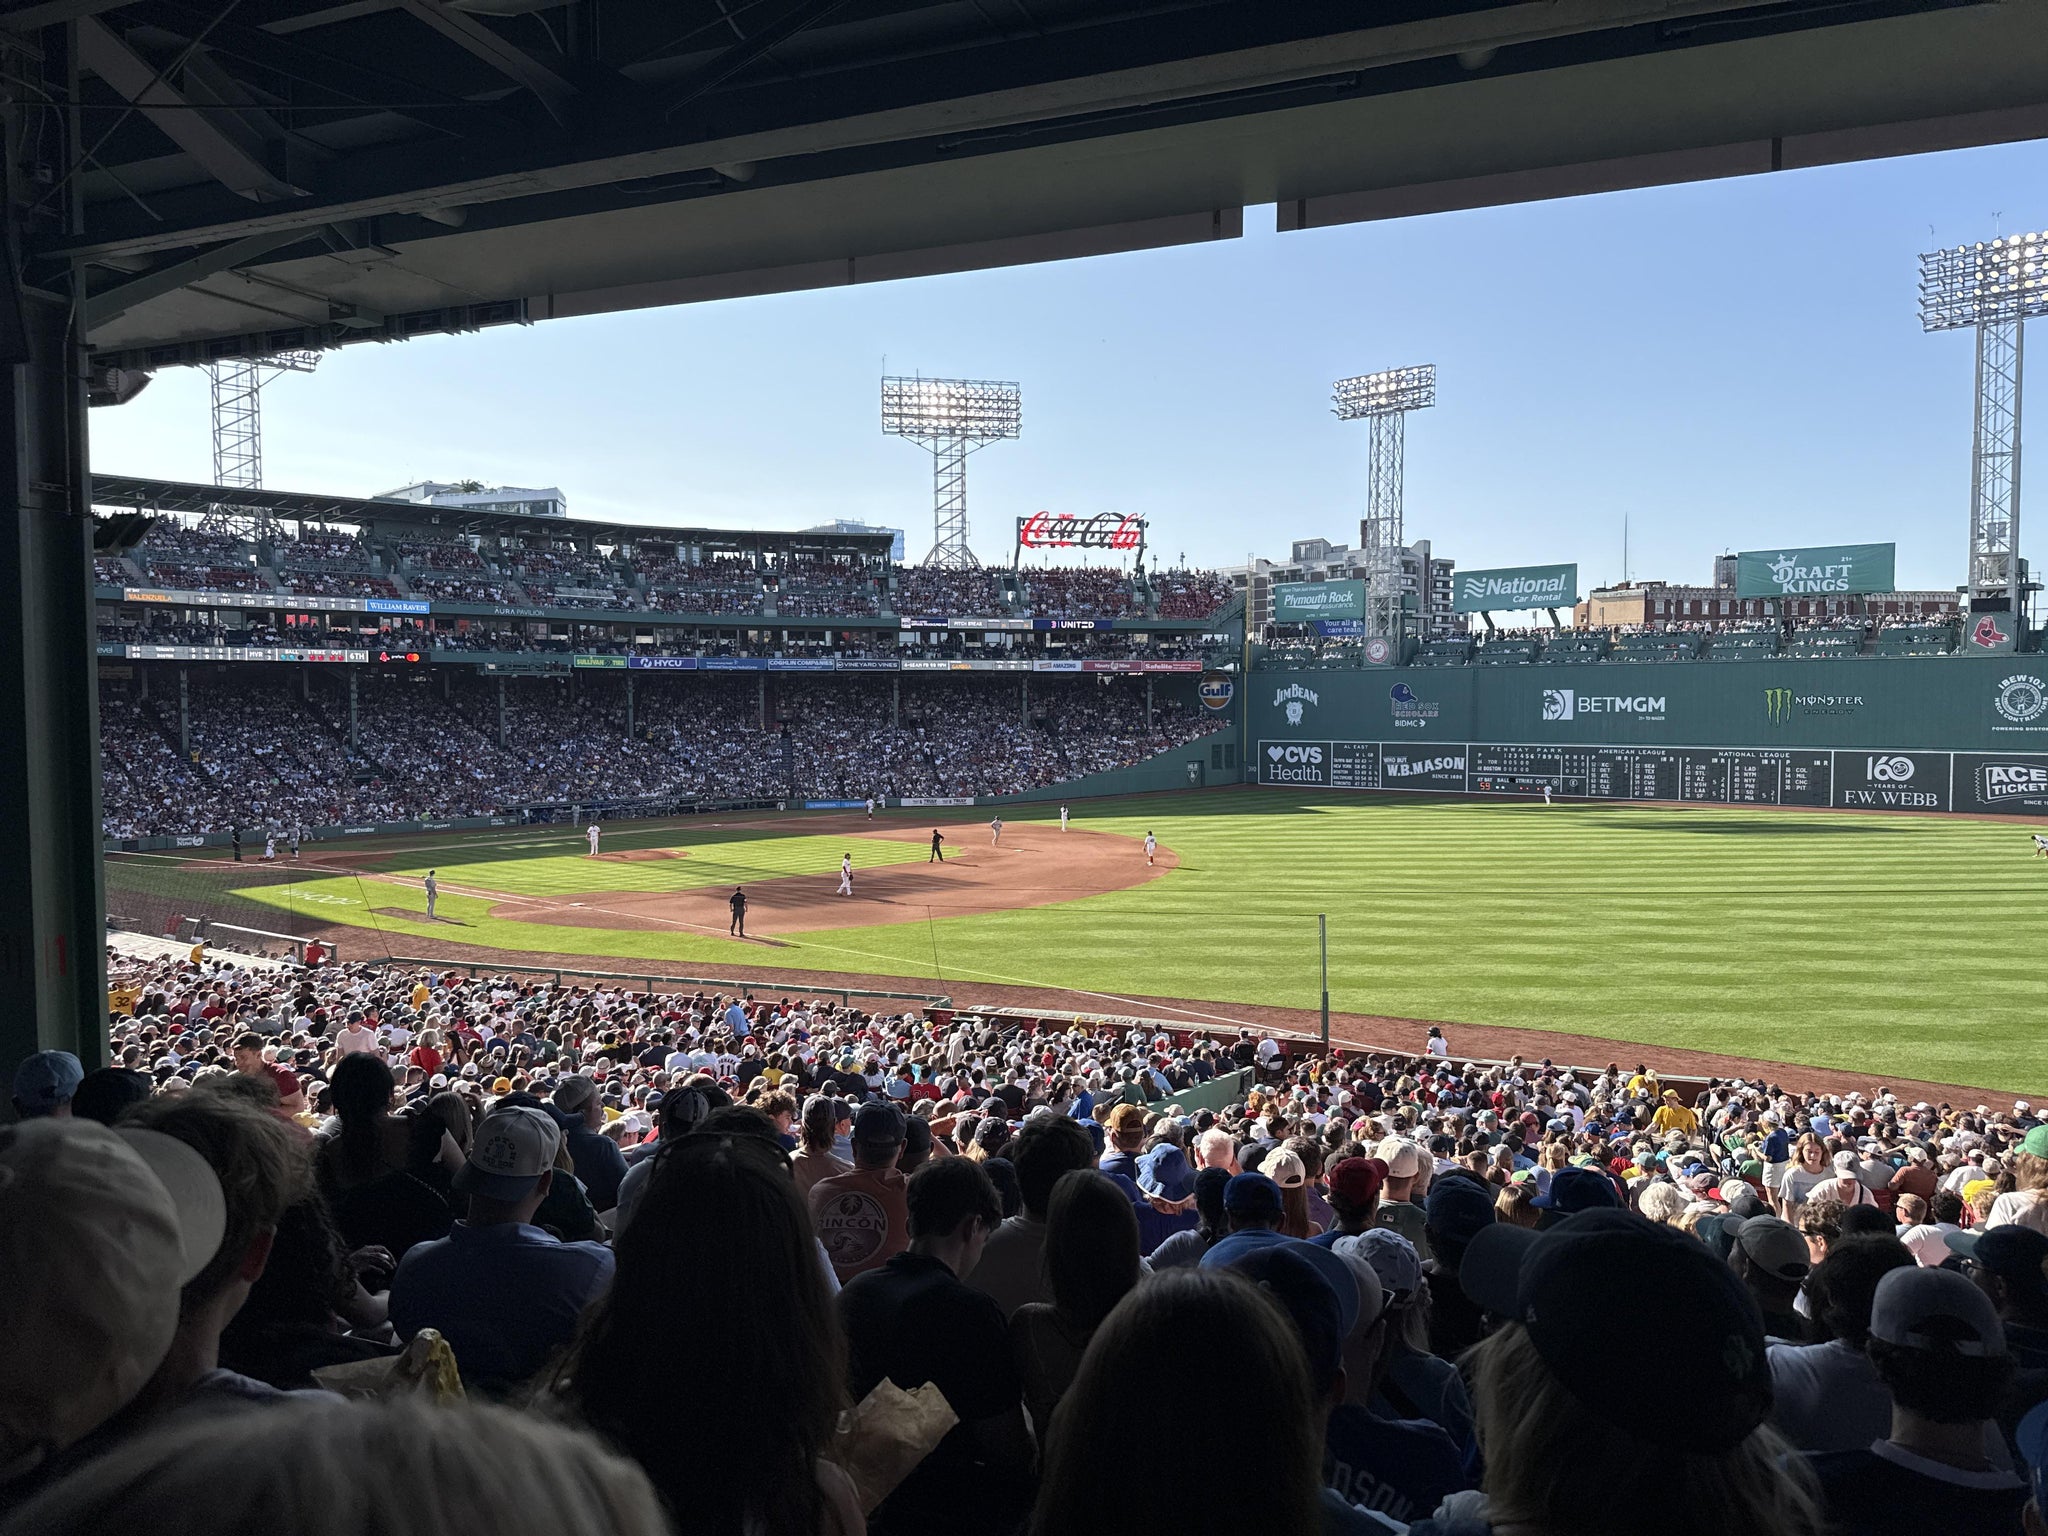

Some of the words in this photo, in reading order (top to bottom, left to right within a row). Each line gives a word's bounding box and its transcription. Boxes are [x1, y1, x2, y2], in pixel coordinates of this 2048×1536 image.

[1022, 511, 1146, 549] Coca-Cola
[1772, 565, 1852, 583] DRAFT
[1782, 579, 1849, 593] KINGS
[128, 593, 172, 602] VALENZUELA
[1284, 592, 1327, 608] Plymouth
[1329, 591, 1354, 603] Rock
[1531, 593, 1561, 602] Rental
[370, 602, 403, 610] WILLIAM
[403, 603, 427, 611] RAVEIS
[1060, 621, 1095, 629] UNITED
[1998, 675, 2028, 690] IBEW
[2028, 676, 2046, 690] 103
[1200, 683, 1232, 697] Gulf
[1273, 688, 1292, 707] JIM
[1291, 683, 1319, 707] BEAM
[1578, 697, 1666, 712] BETMGM
[1795, 695, 1864, 706] MONSTER
[1395, 710, 1439, 718] SCHOLARS
[1994, 697, 2005, 714] NECA
[2003, 697, 2048, 722] CONTRACTORS
[1285, 746, 1322, 763] CVS
[1269, 764, 1322, 781] Health
[1867, 756, 1915, 782] 160
[1991, 766, 2048, 783] ACE
[1480, 782, 1490, 790] 59
[1992, 782, 2048, 794] TICKET
[1845, 790, 1877, 805] F.W.
[1882, 792, 1938, 807] WEBB
[344, 826, 375, 834] smartwater
[115, 997, 130, 1008] 32
[720, 1064, 731, 1076] 11
[485, 1136, 517, 1160] BOSTON
